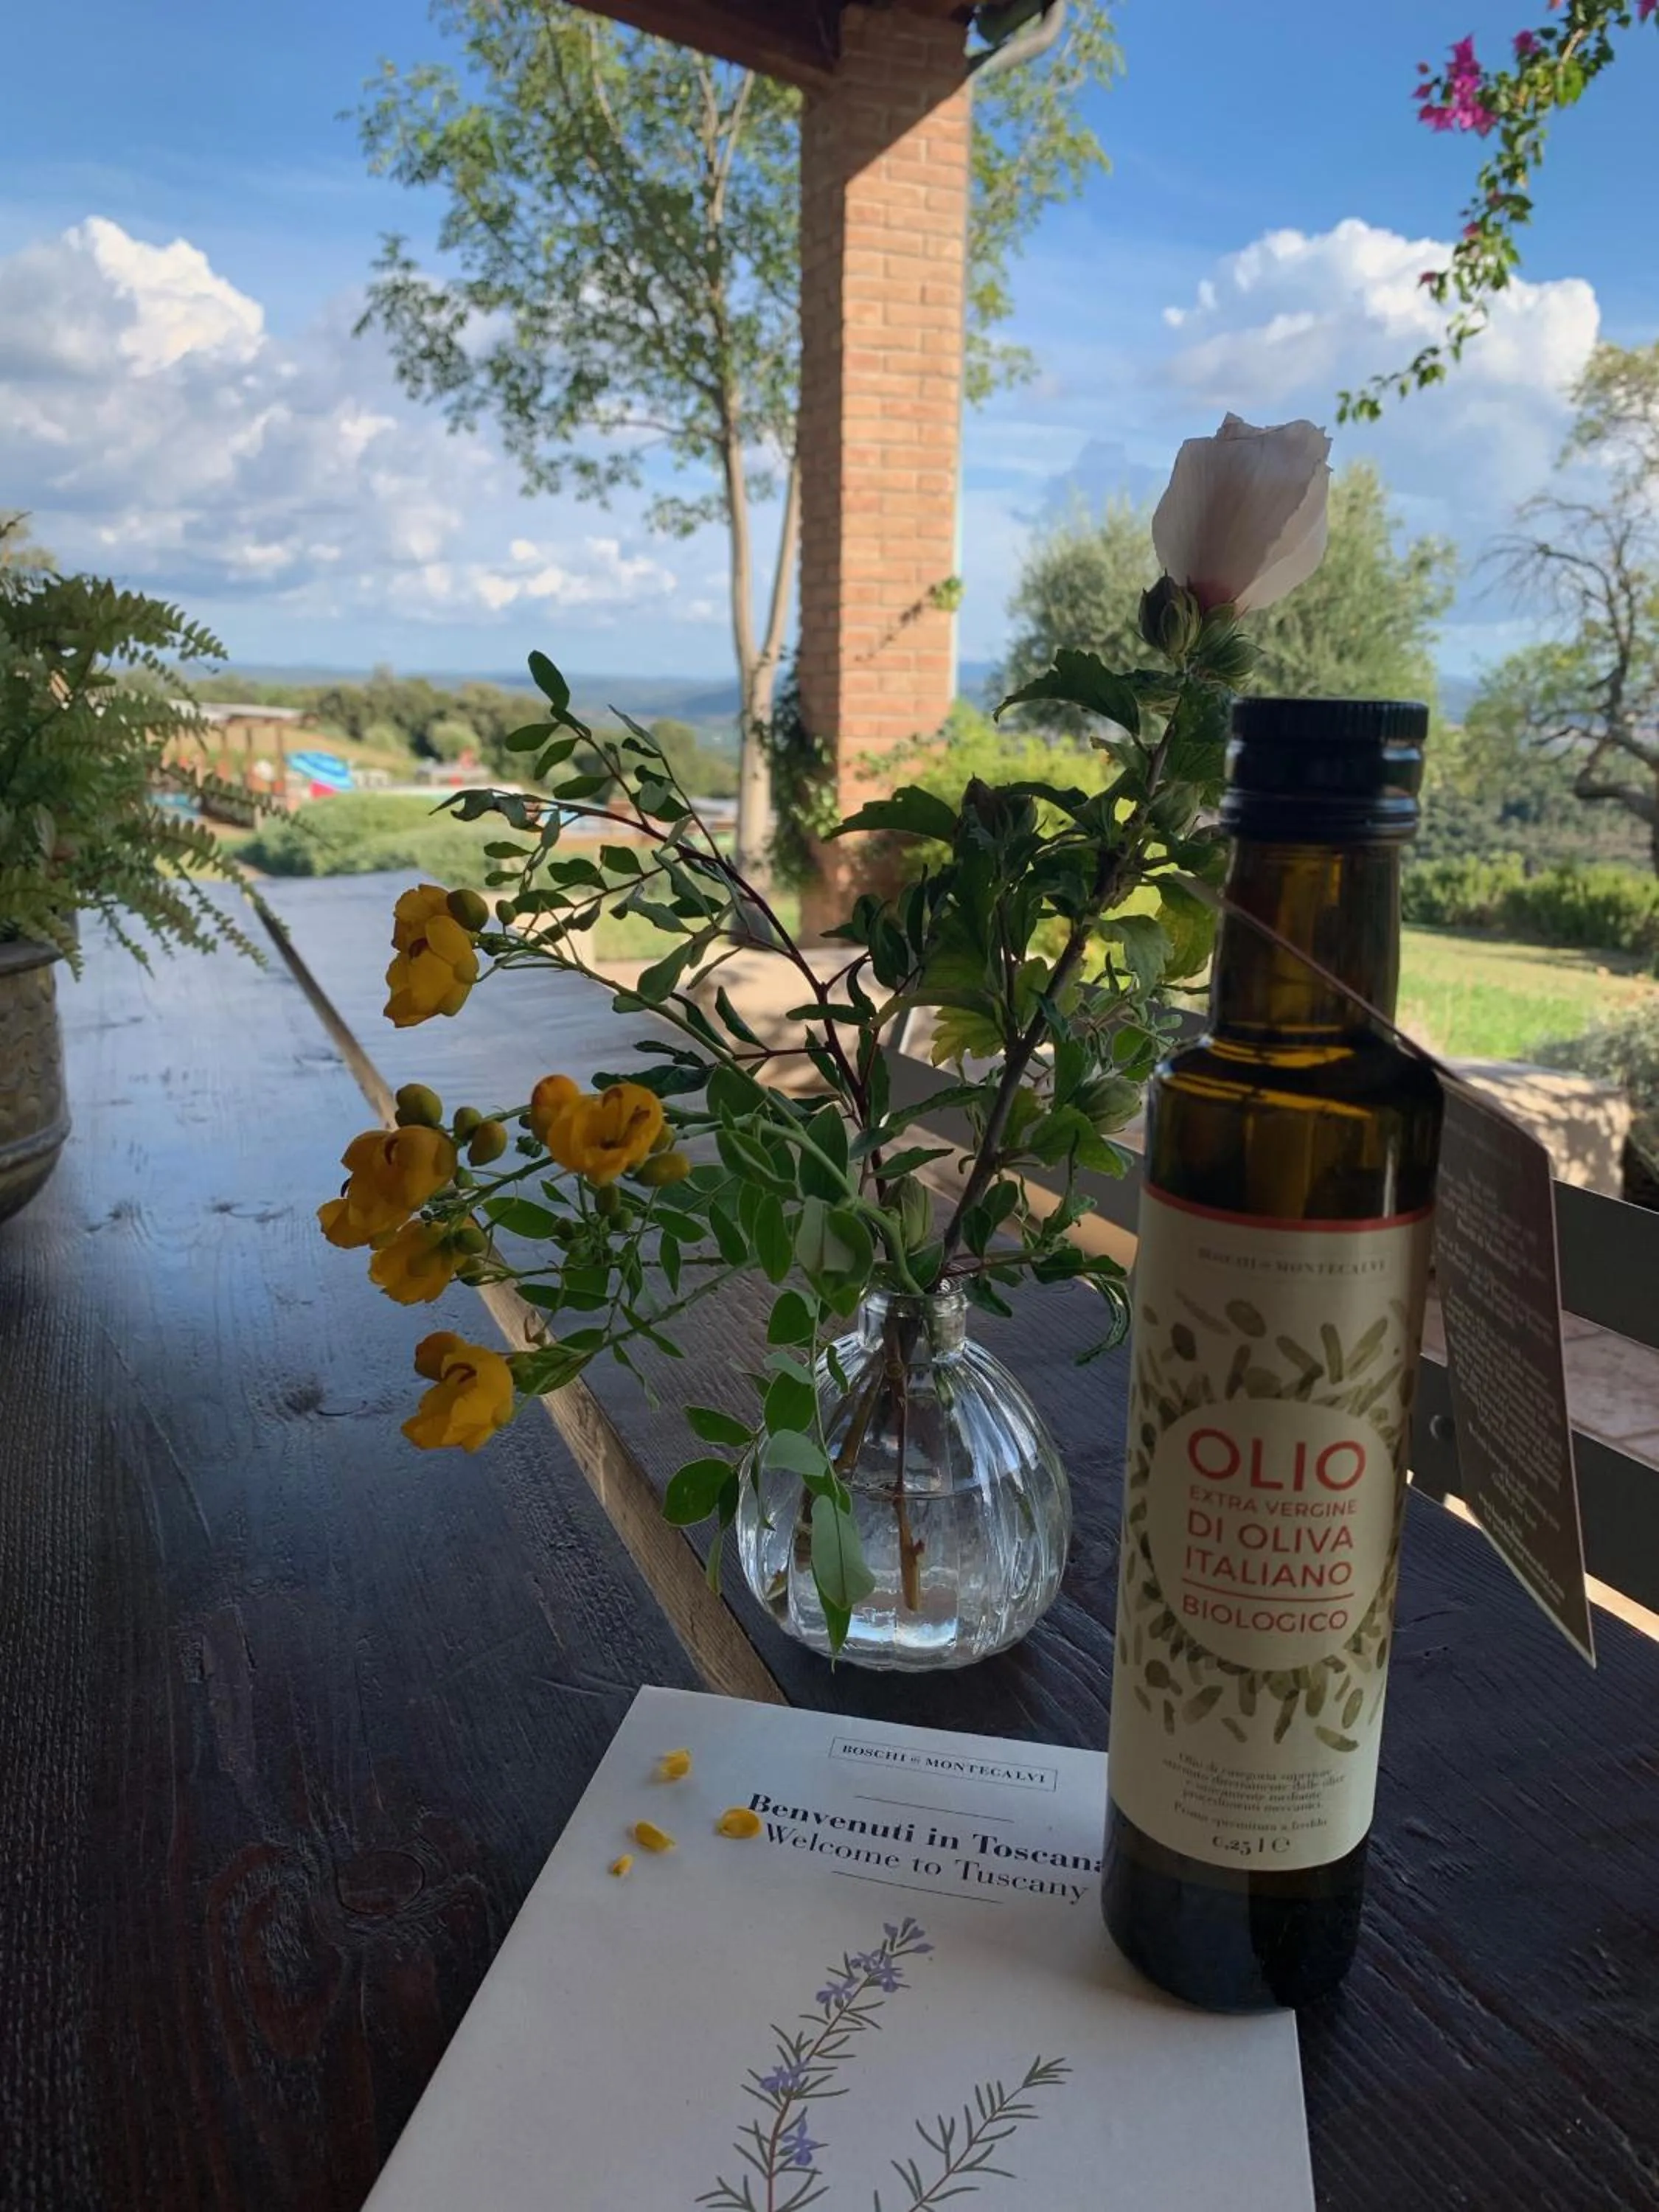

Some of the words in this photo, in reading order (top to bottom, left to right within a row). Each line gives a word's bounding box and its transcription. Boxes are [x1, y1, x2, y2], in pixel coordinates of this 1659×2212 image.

[1187, 1427, 1366, 1492] OLIO
[1189, 1485, 1260, 1514] EXTRA
[1266, 1498, 1357, 1517] VERGINE
[1187, 1509, 1223, 1543] DI
[1239, 1523, 1354, 1554] OLIVA
[1185, 1545, 1352, 1586] ITALIANO
[1182, 1596, 1349, 1632] BIOLOGICO
[842, 1743, 907, 1762] BOSCHI
[925, 1757, 1046, 1784] MONTECALVI
[746, 1792, 915, 1843] Benvenuti
[927, 1827, 959, 1851] in
[765, 1823, 900, 1869] Welcome
[912, 1857, 942, 1876] to
[955, 1859, 1088, 1905] Tuscany
[1211, 1834, 1252, 1857] 0,25
